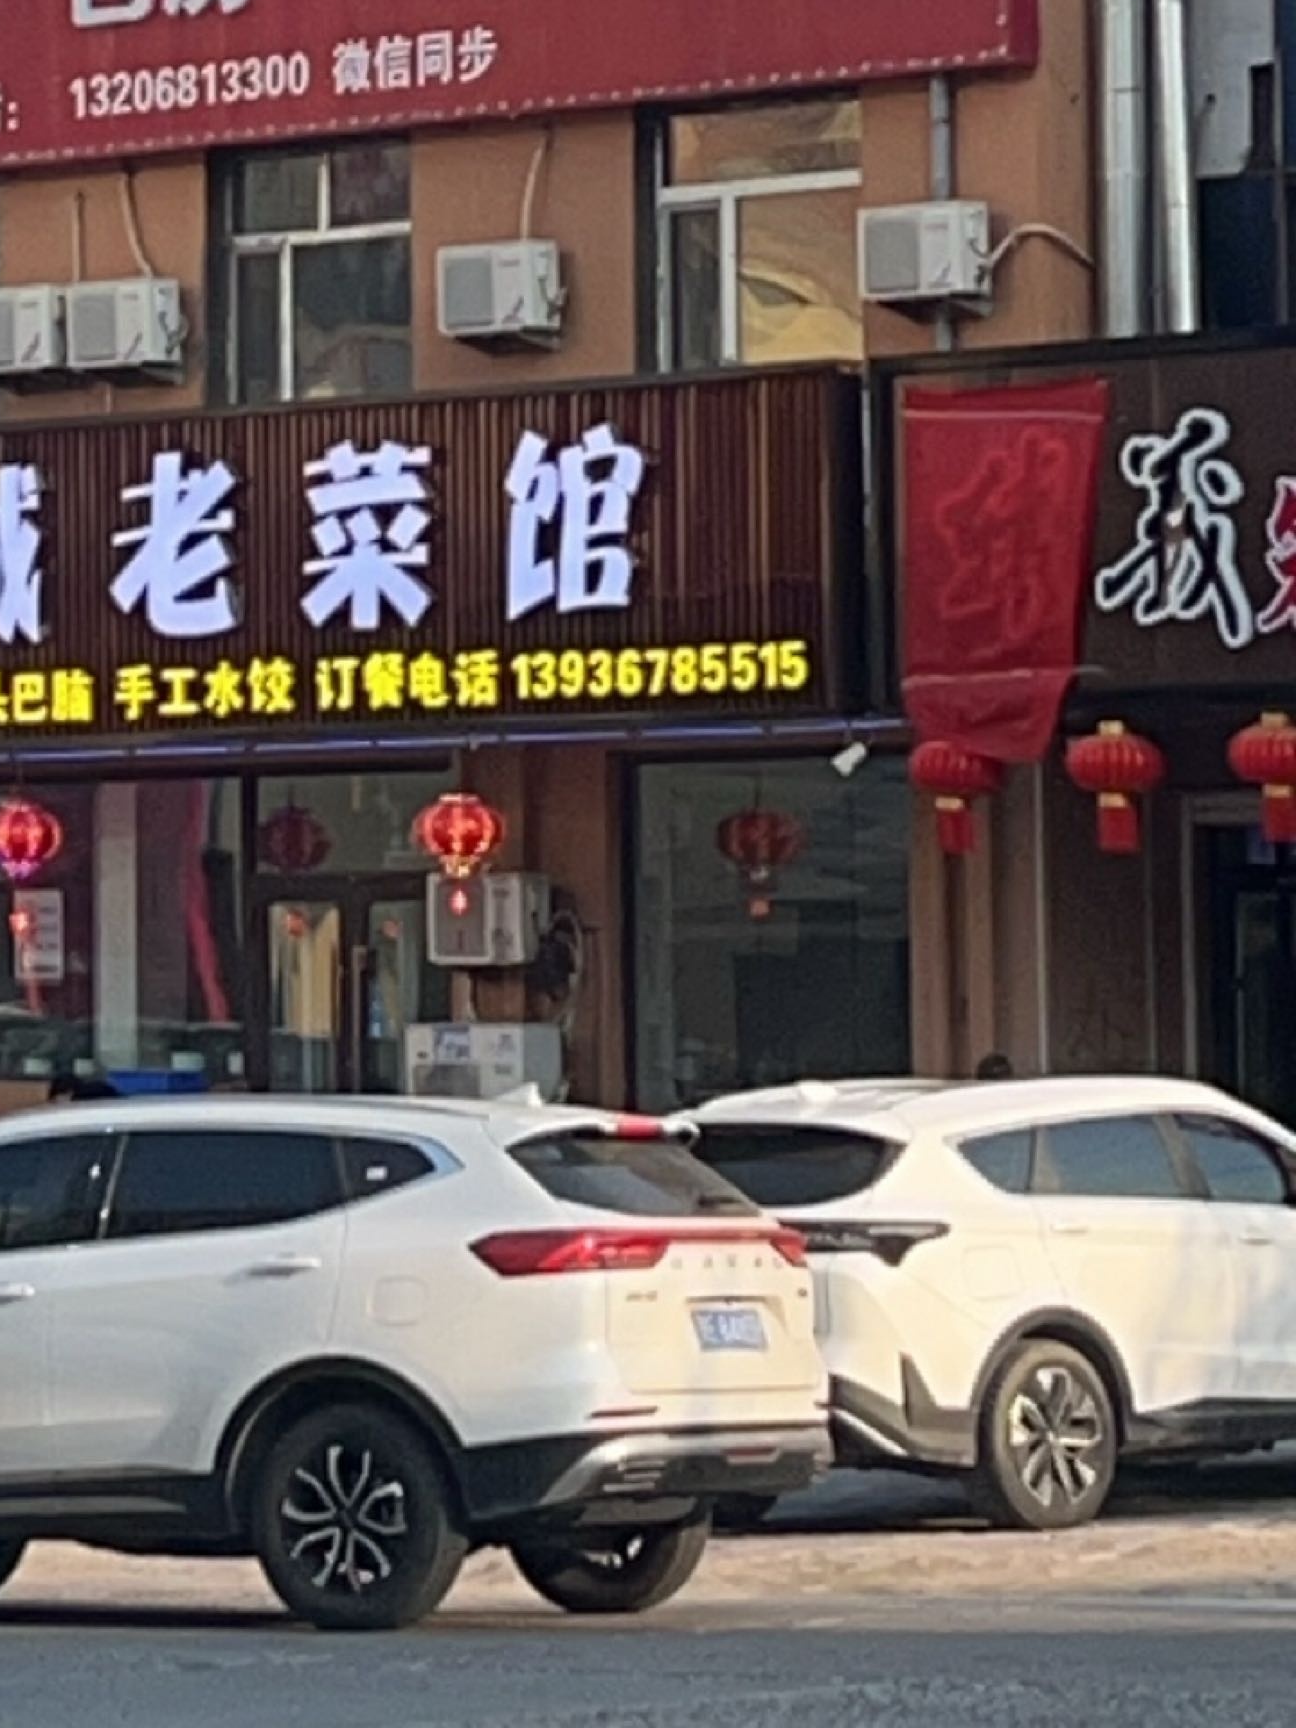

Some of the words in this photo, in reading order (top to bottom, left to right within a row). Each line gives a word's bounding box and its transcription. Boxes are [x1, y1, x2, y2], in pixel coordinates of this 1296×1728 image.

[68, 51, 311, 120] 13206813300
[331, 24, 498, 97] 微信同步
[114, 656, 296, 721] 手工水饺
[315, 648, 501, 711] 订餐电话
[511, 639, 809, 701] 13936785515
